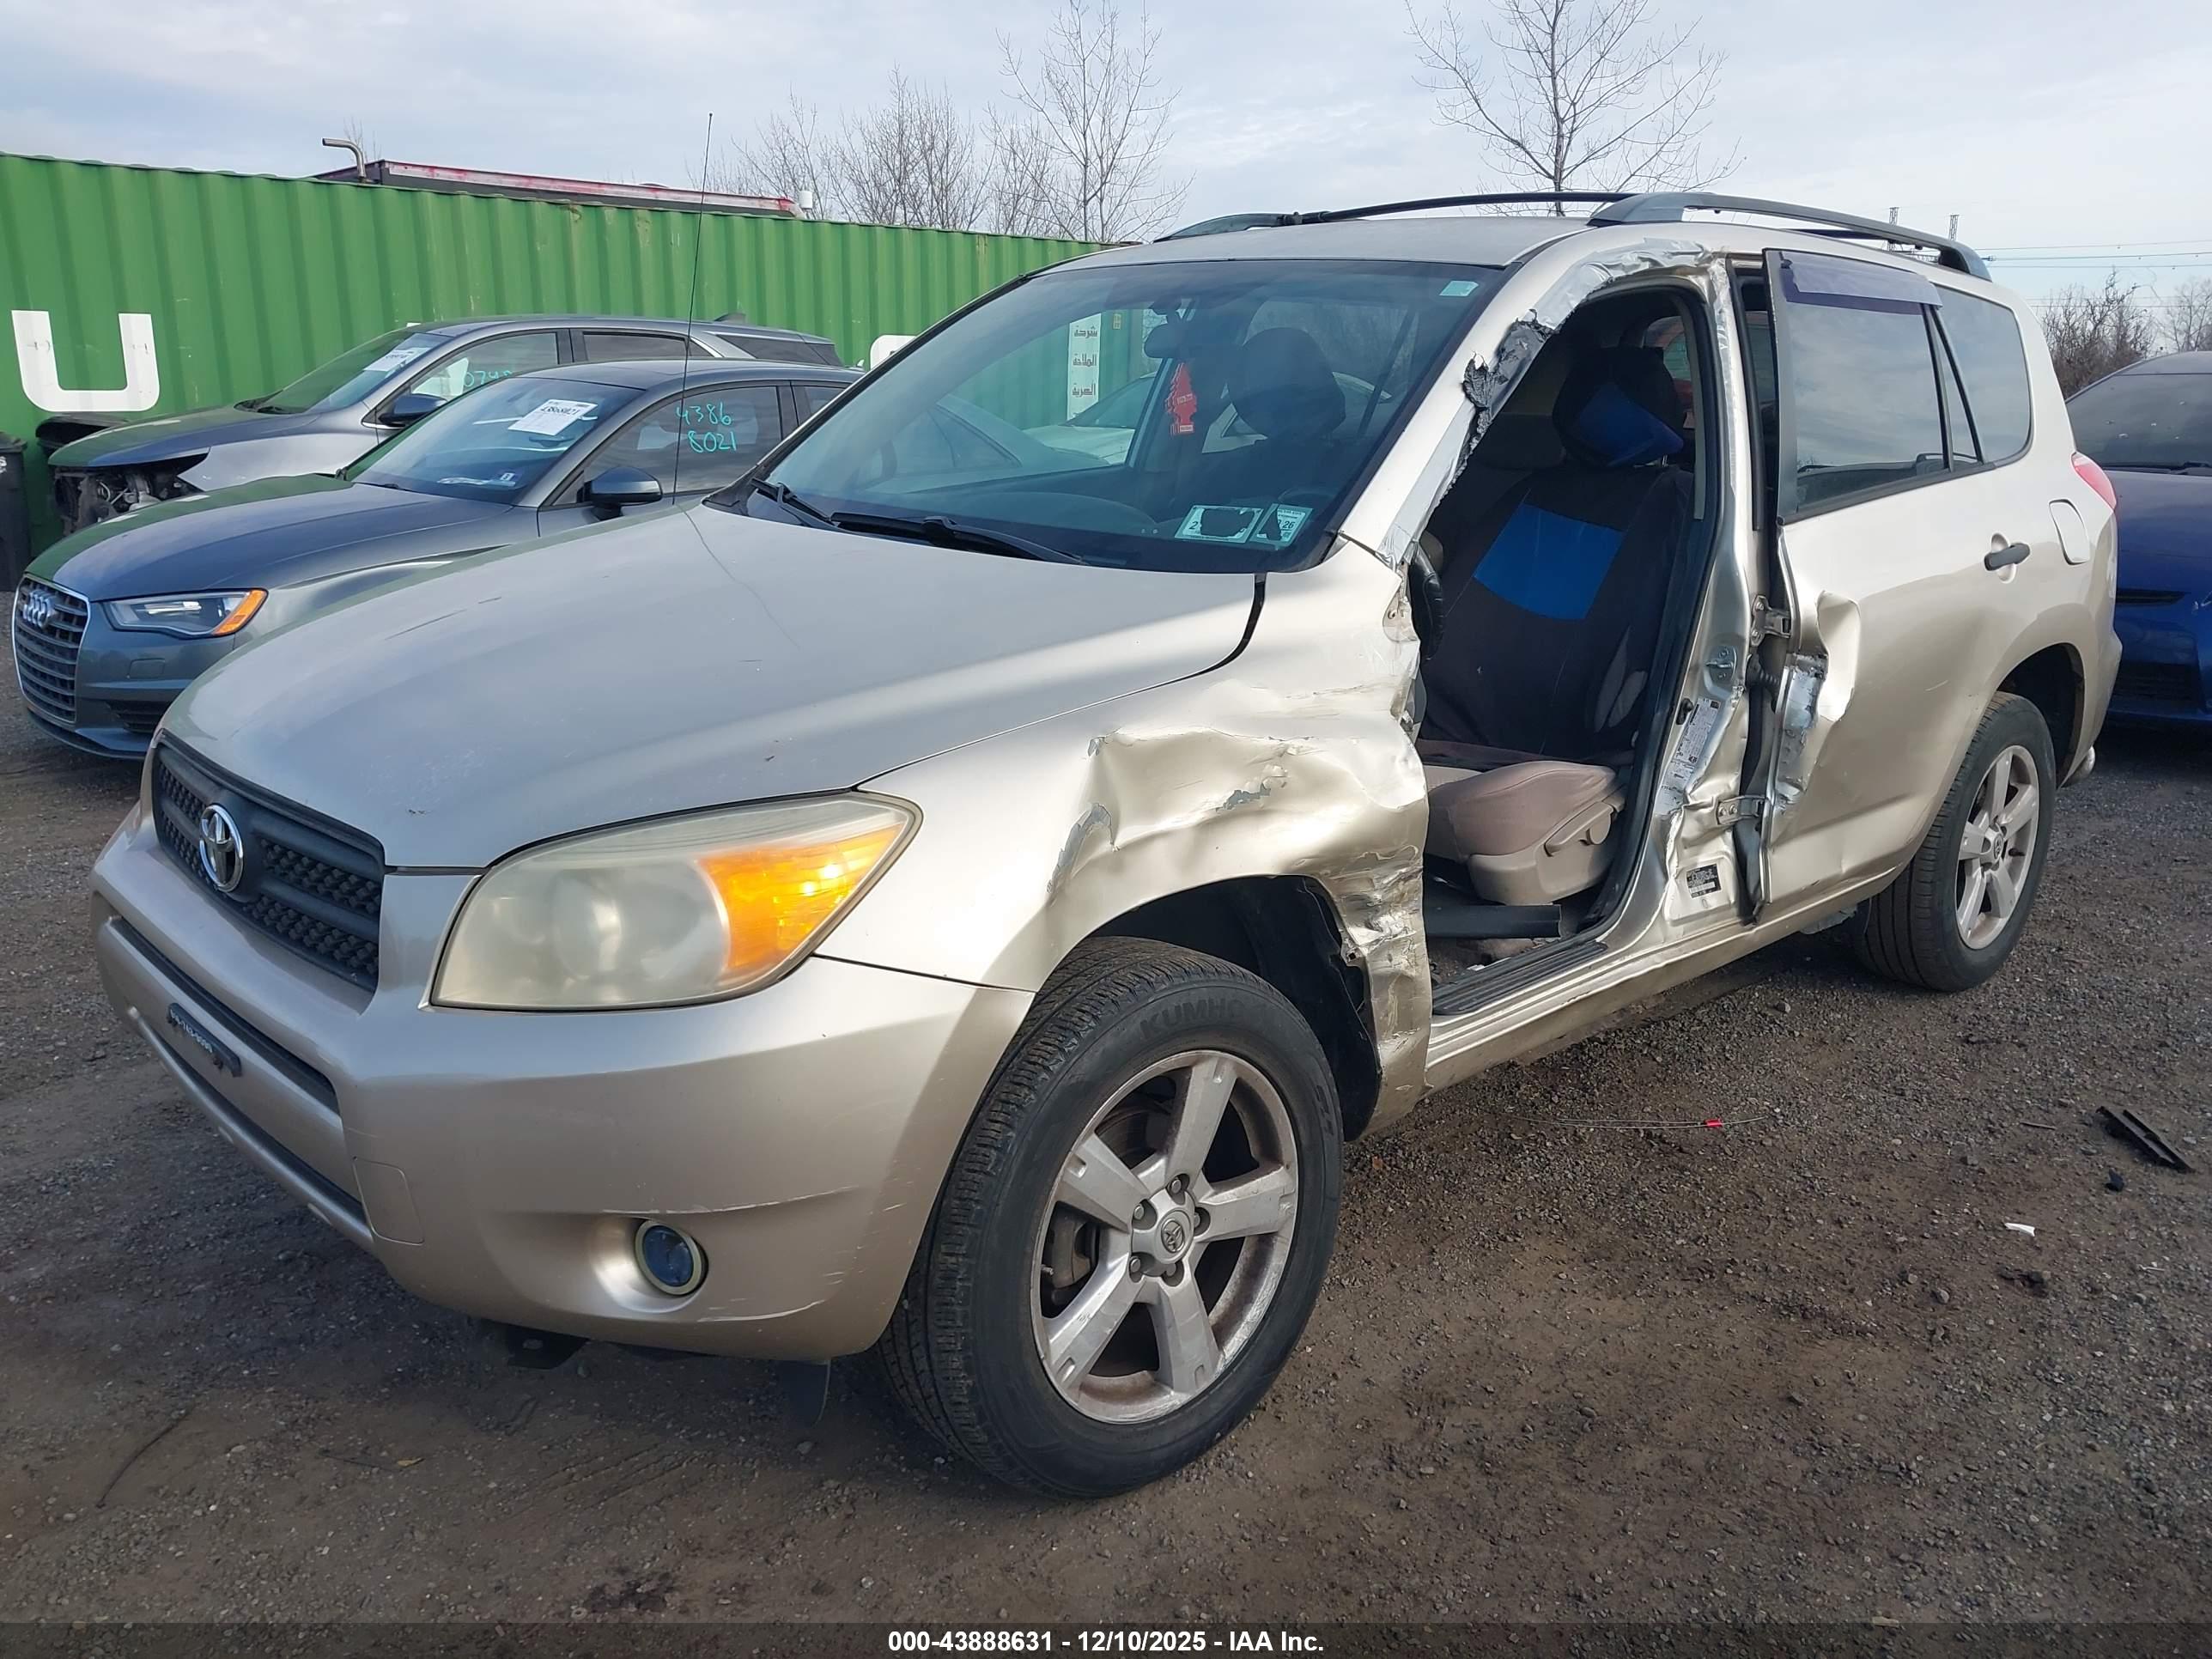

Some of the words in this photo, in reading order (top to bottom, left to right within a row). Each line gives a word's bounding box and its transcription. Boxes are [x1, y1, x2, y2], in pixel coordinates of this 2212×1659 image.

[464, 370, 513, 387] 074
[676, 401, 732, 426] 4386
[688, 430, 737, 453] 8021
